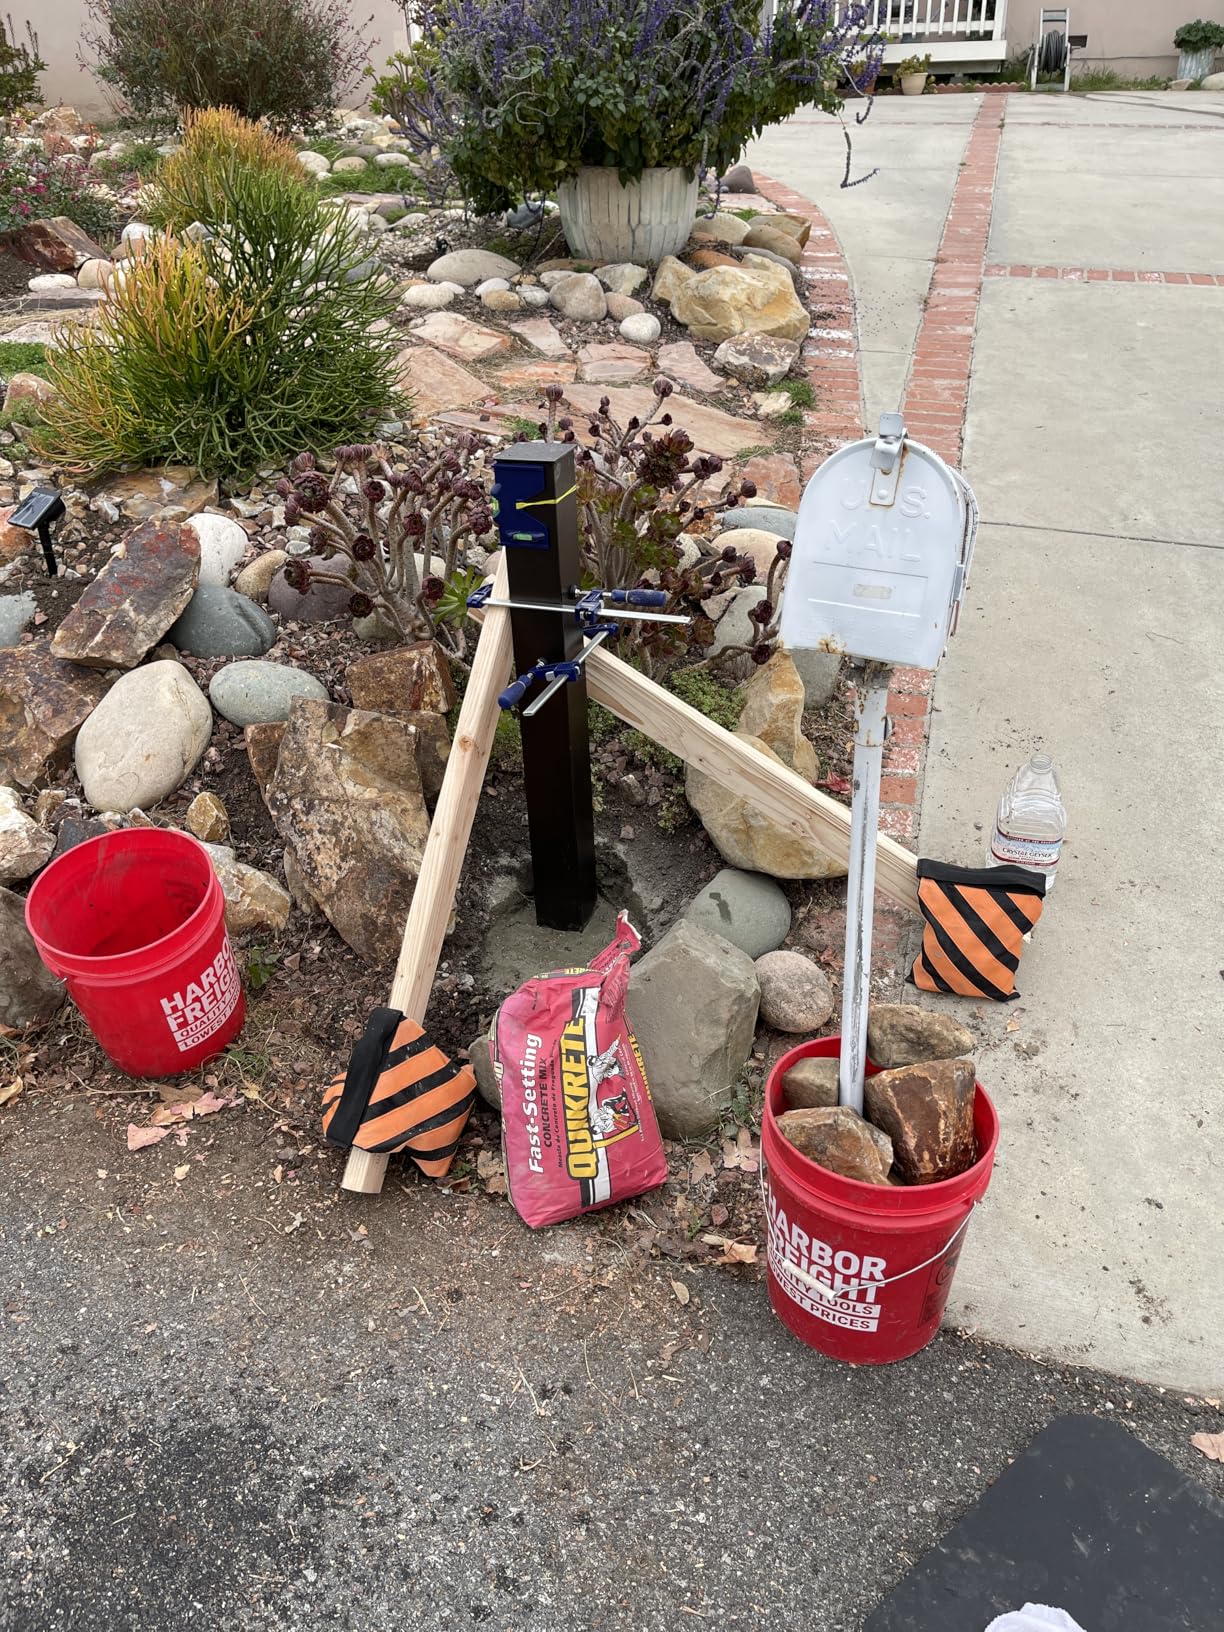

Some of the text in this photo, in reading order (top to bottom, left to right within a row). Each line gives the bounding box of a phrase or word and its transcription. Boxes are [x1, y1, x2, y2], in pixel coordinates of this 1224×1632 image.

[825, 519, 921, 563] MAIL
[166, 950, 235, 1033] FREIGH
[181, 999, 227, 1038] QUALITY
[184, 1012, 228, 1048] LOWEST
[519, 1033, 544, 1174] Fast-Setting
[539, 1057, 552, 1148] CONCRETE MIX
[560, 1016, 599, 1180] QUIKRETE
[768, 1183, 887, 1281] HARBOR
[810, 1303, 870, 1330] PRICES
